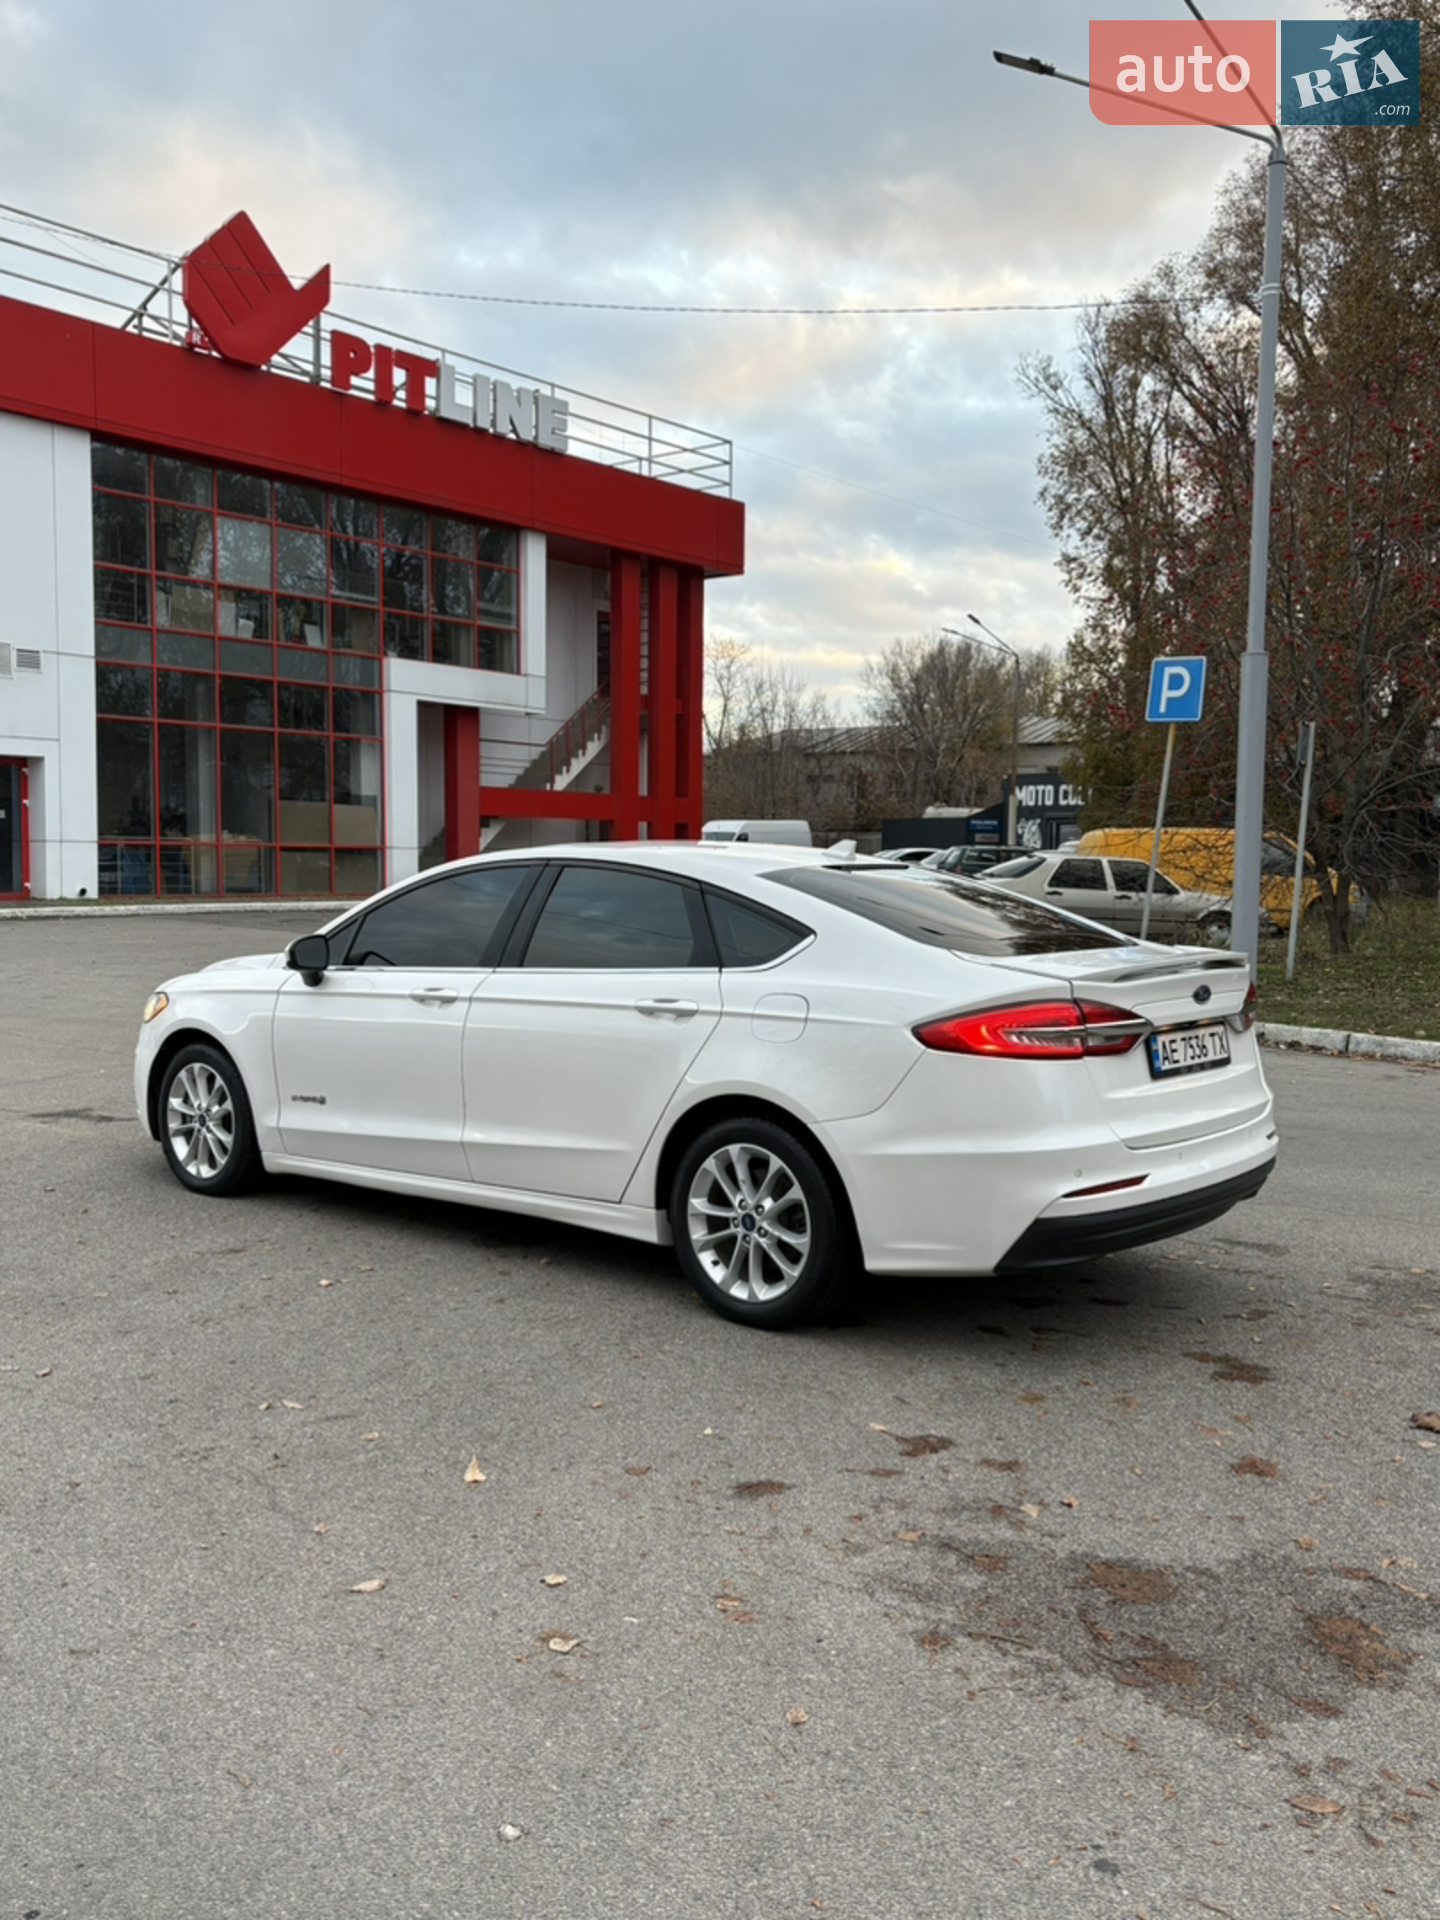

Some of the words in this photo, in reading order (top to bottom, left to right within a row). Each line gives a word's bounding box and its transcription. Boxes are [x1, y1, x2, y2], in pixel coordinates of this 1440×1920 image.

[1159, 666, 1191, 714] P
[1015, 784, 1054, 806] MOTO
[1161, 1039, 1180, 1066] AE
[1181, 1034, 1208, 1062] 7536
[1209, 1031, 1228, 1056] TX
